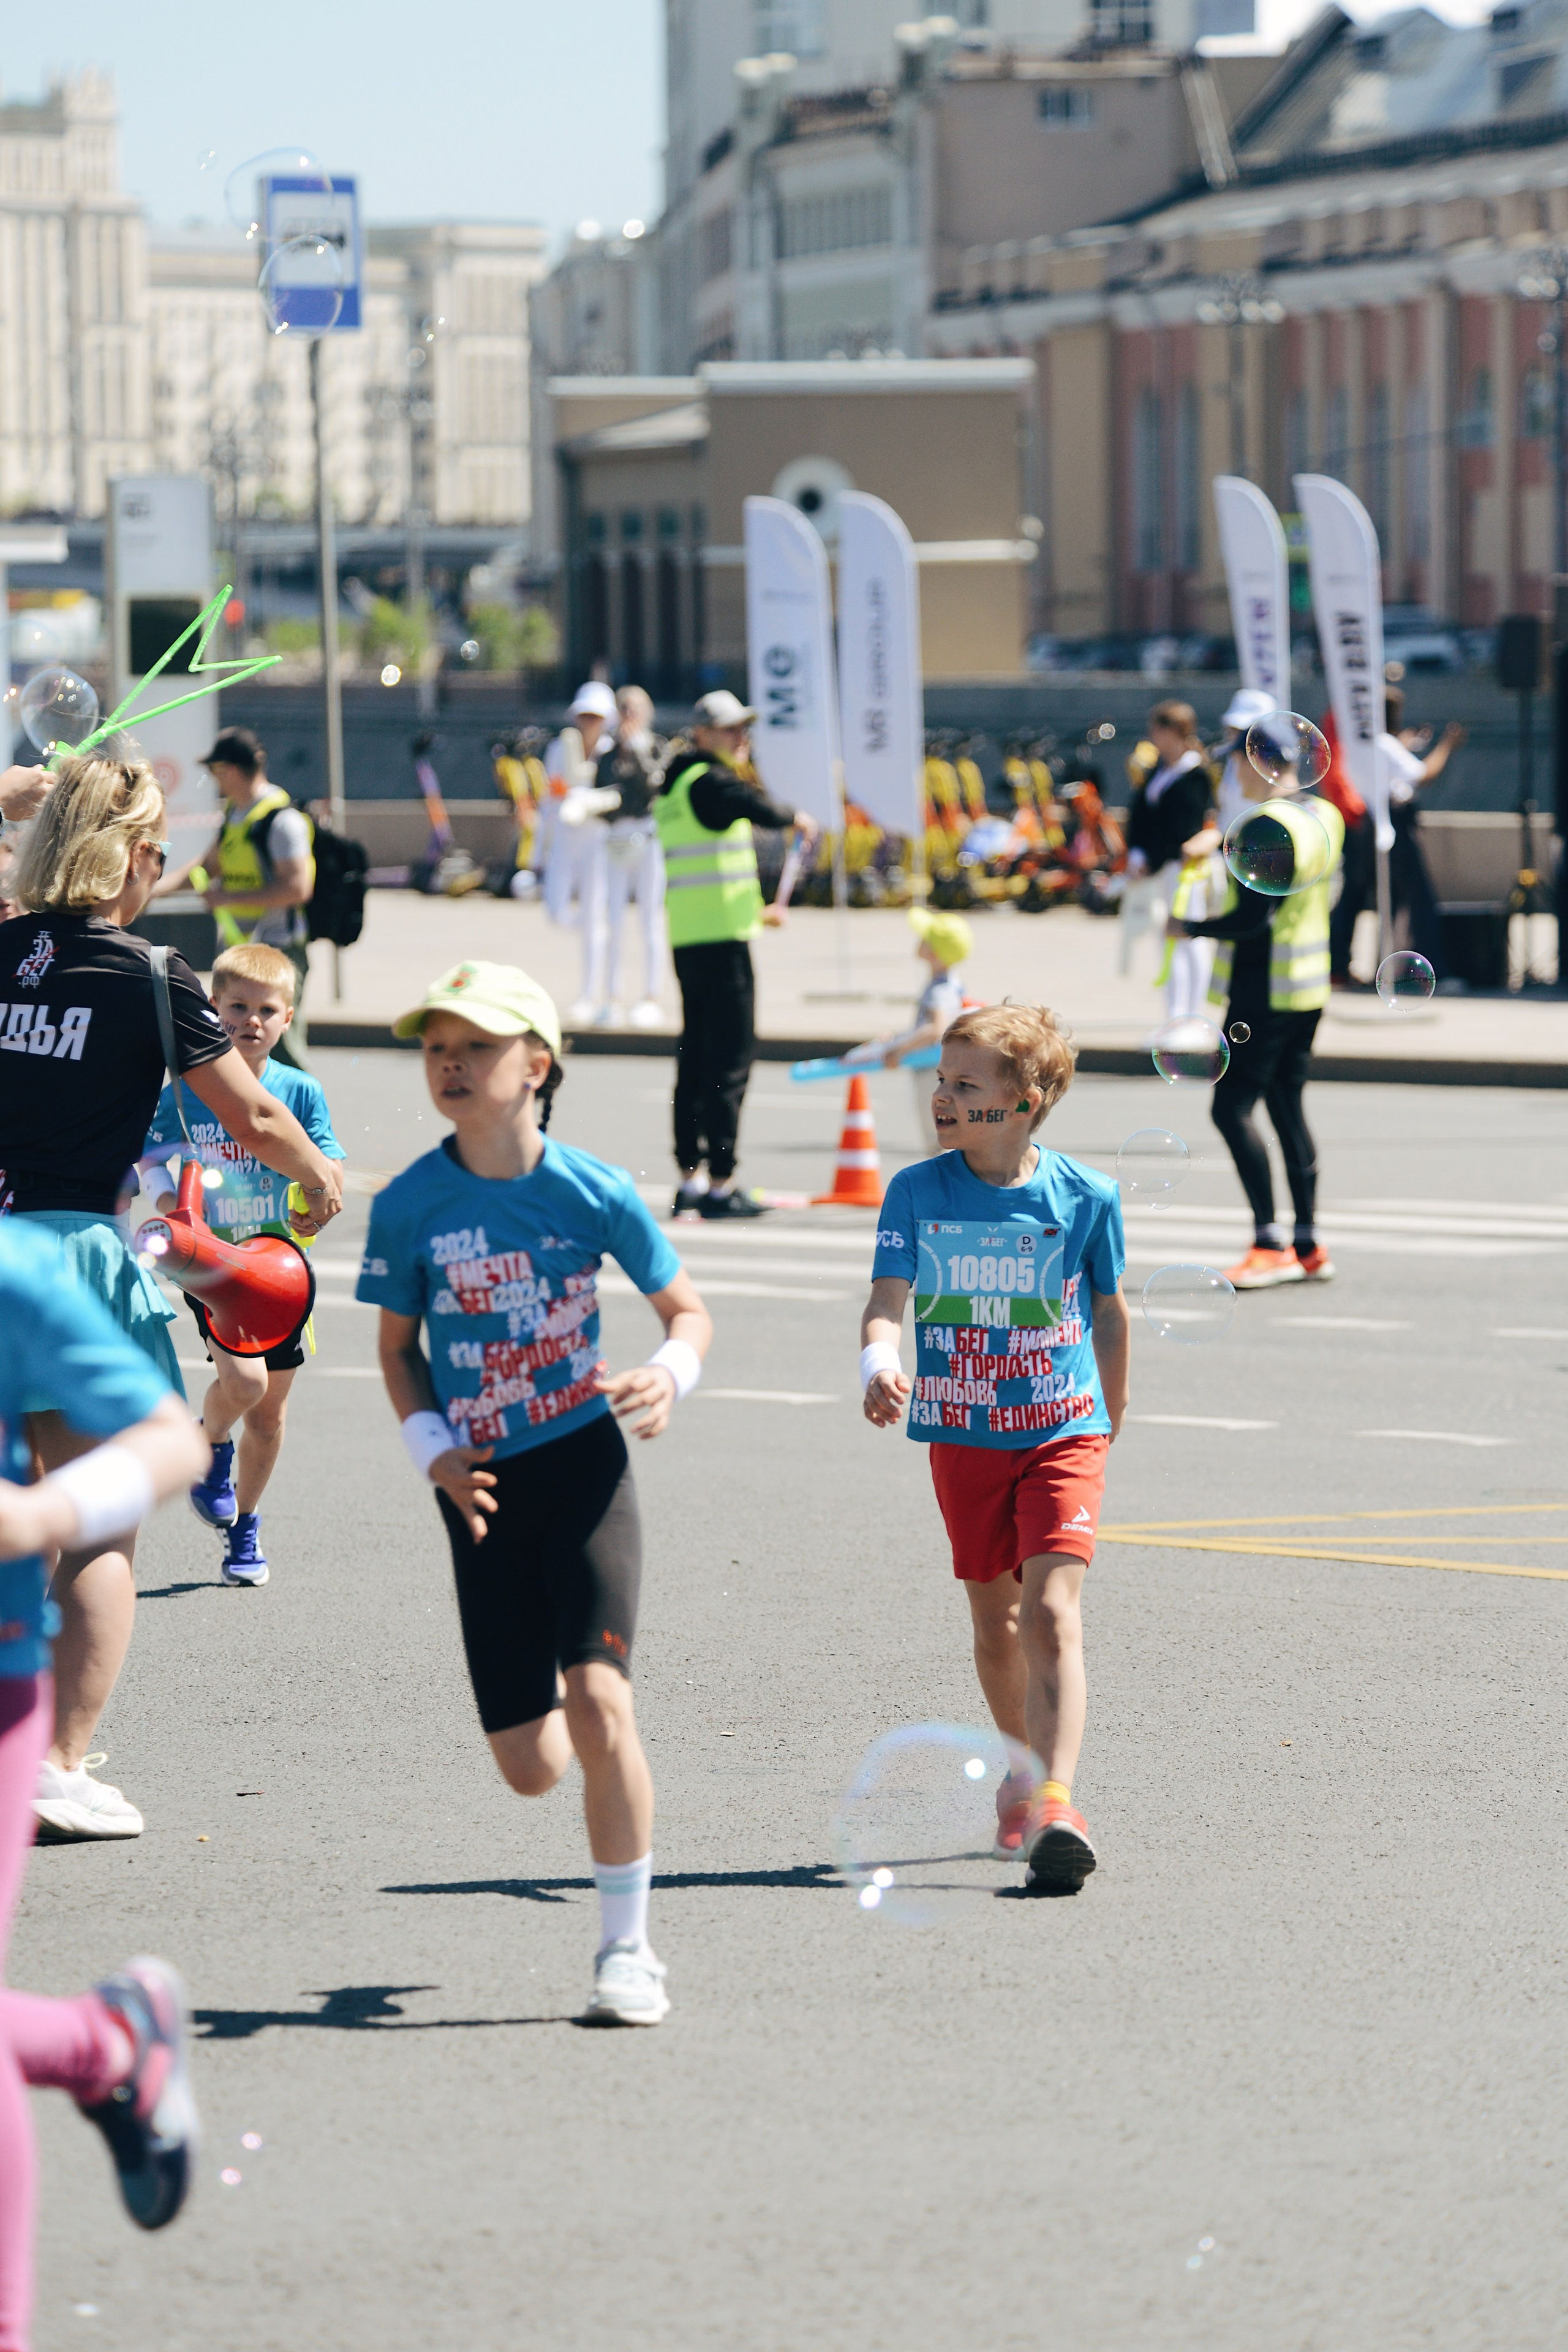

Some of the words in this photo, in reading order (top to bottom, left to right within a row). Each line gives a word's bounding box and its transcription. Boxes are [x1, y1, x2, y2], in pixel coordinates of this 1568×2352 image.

[0, 1003, 92, 1060] ДЬЯ
[147, 1126, 164, 1142] СБ
[191, 1123, 225, 1143] 2024
[216, 1194, 274, 1224] 10501
[941, 1225, 962, 1234] ПСБ
[1022, 1236, 1031, 1245] D
[430, 1226, 489, 1265] 2024
[948, 1255, 1035, 1293] 10805
[948, 1349, 1053, 1381] #ГОРДОСТЬ
[915, 1376, 997, 1407] #ЛЮБОВЬ
[1031, 1372, 1076, 1403] 2024
[988, 1392, 1095, 1432] #ЕДИНСТВО
[1061, 1522, 1094, 1536] DEMIX
